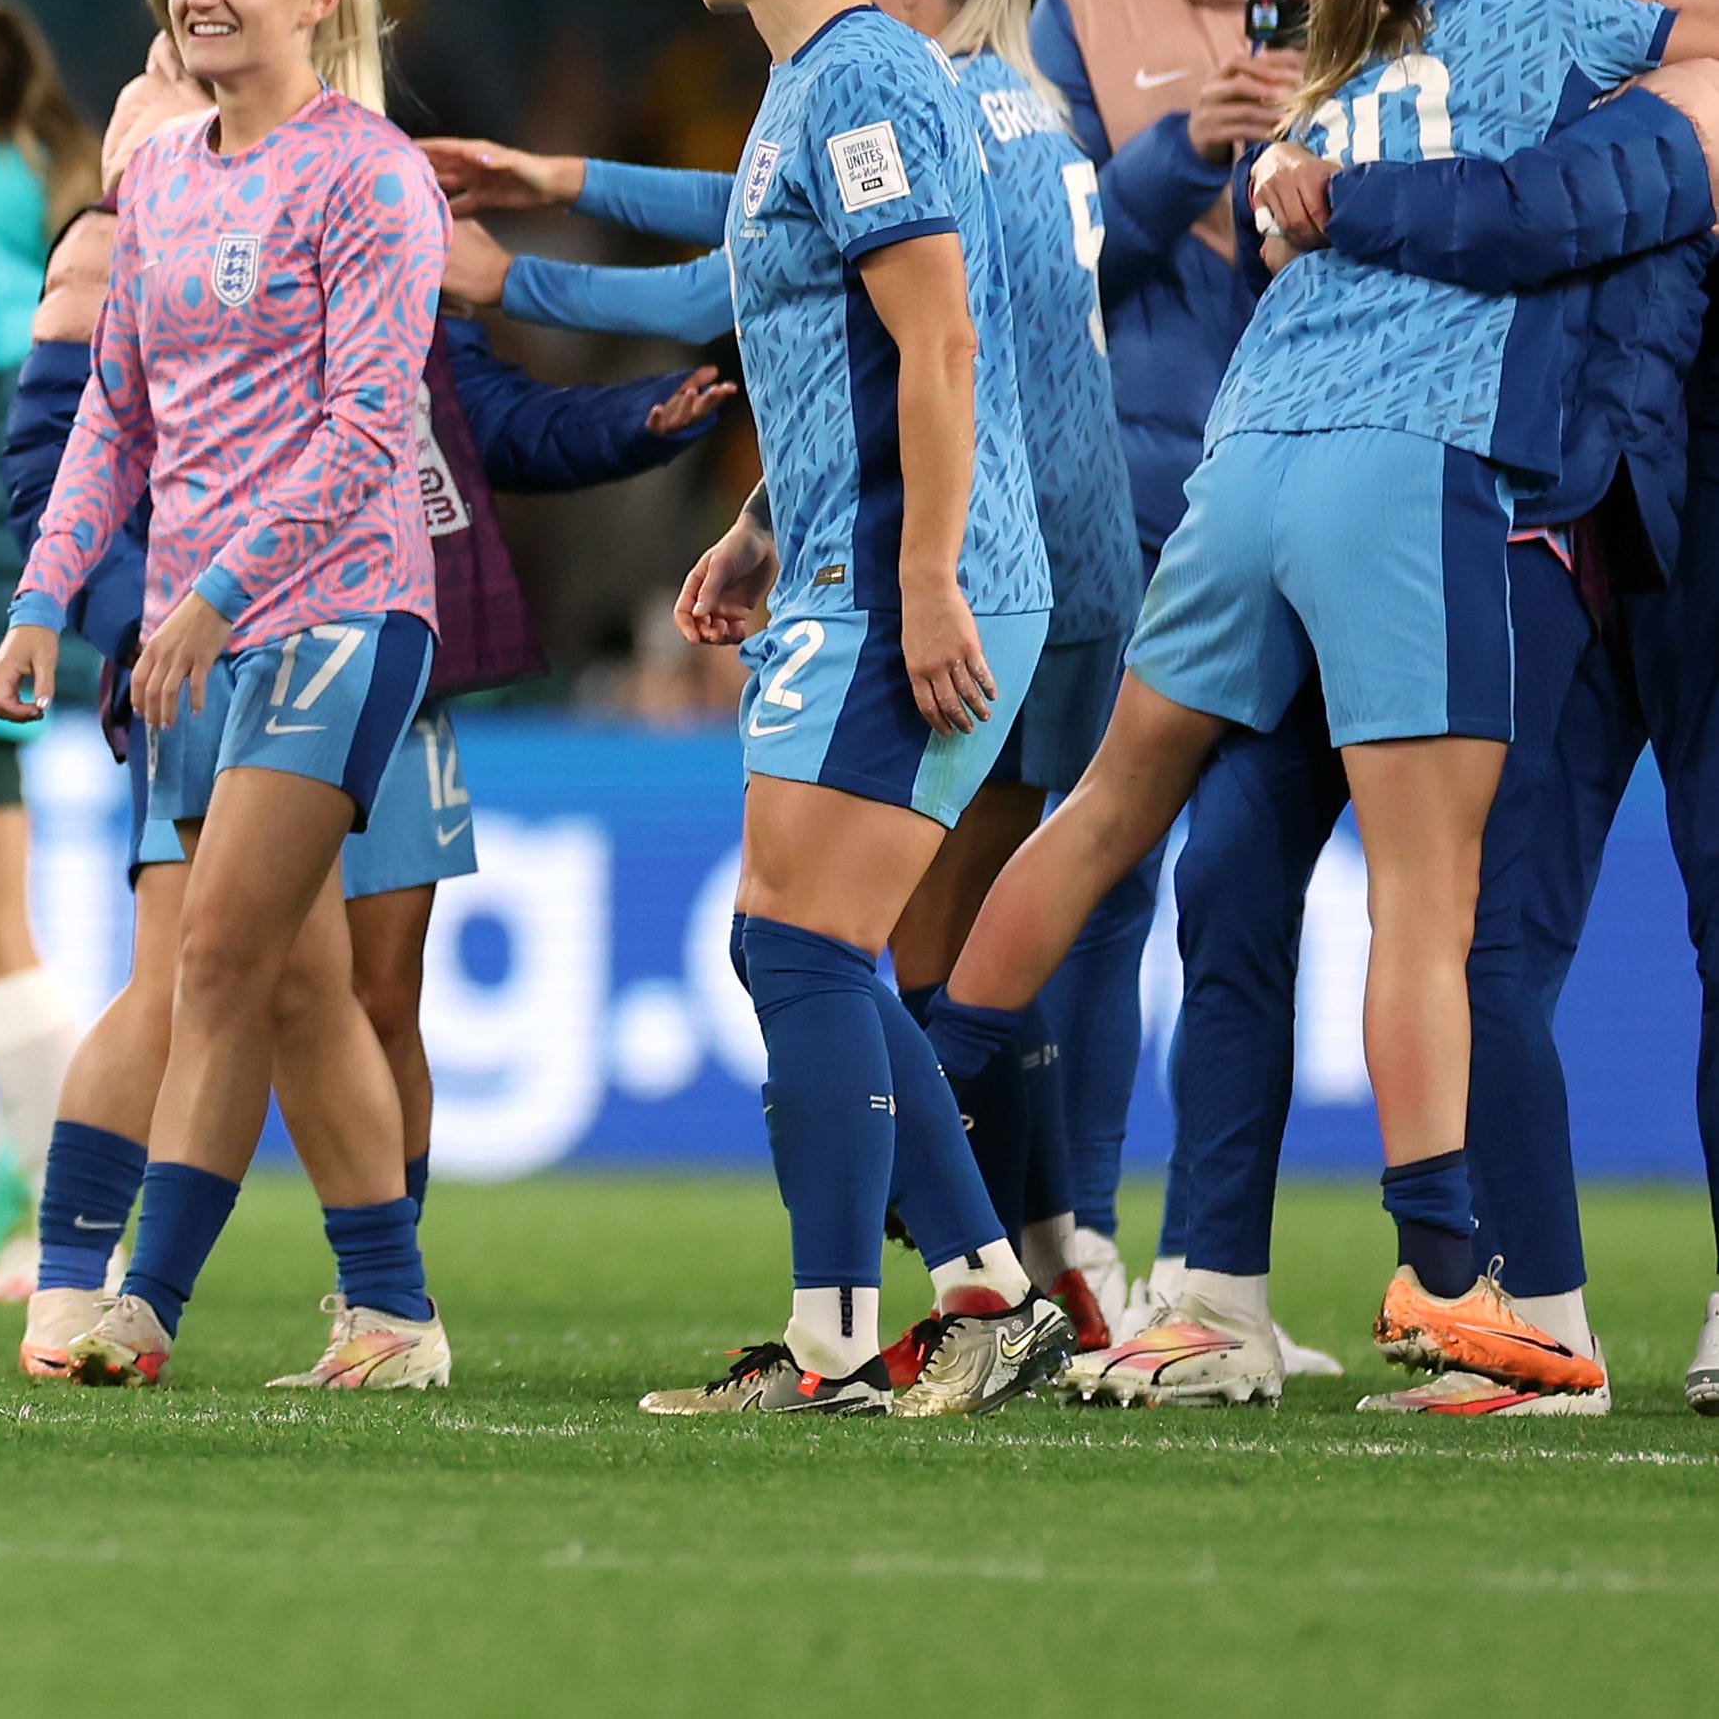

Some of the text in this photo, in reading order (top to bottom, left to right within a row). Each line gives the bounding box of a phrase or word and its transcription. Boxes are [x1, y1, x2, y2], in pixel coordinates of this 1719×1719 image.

[843, 138, 879, 157] FOOTBALL
[846, 148, 884, 170] UNITES
[849, 160, 889, 182] the World
[862, 178, 882, 190] FIFA
[269, 624, 366, 710] 17
[764, 620, 825, 711] 2
[416, 712, 469, 810] 12
